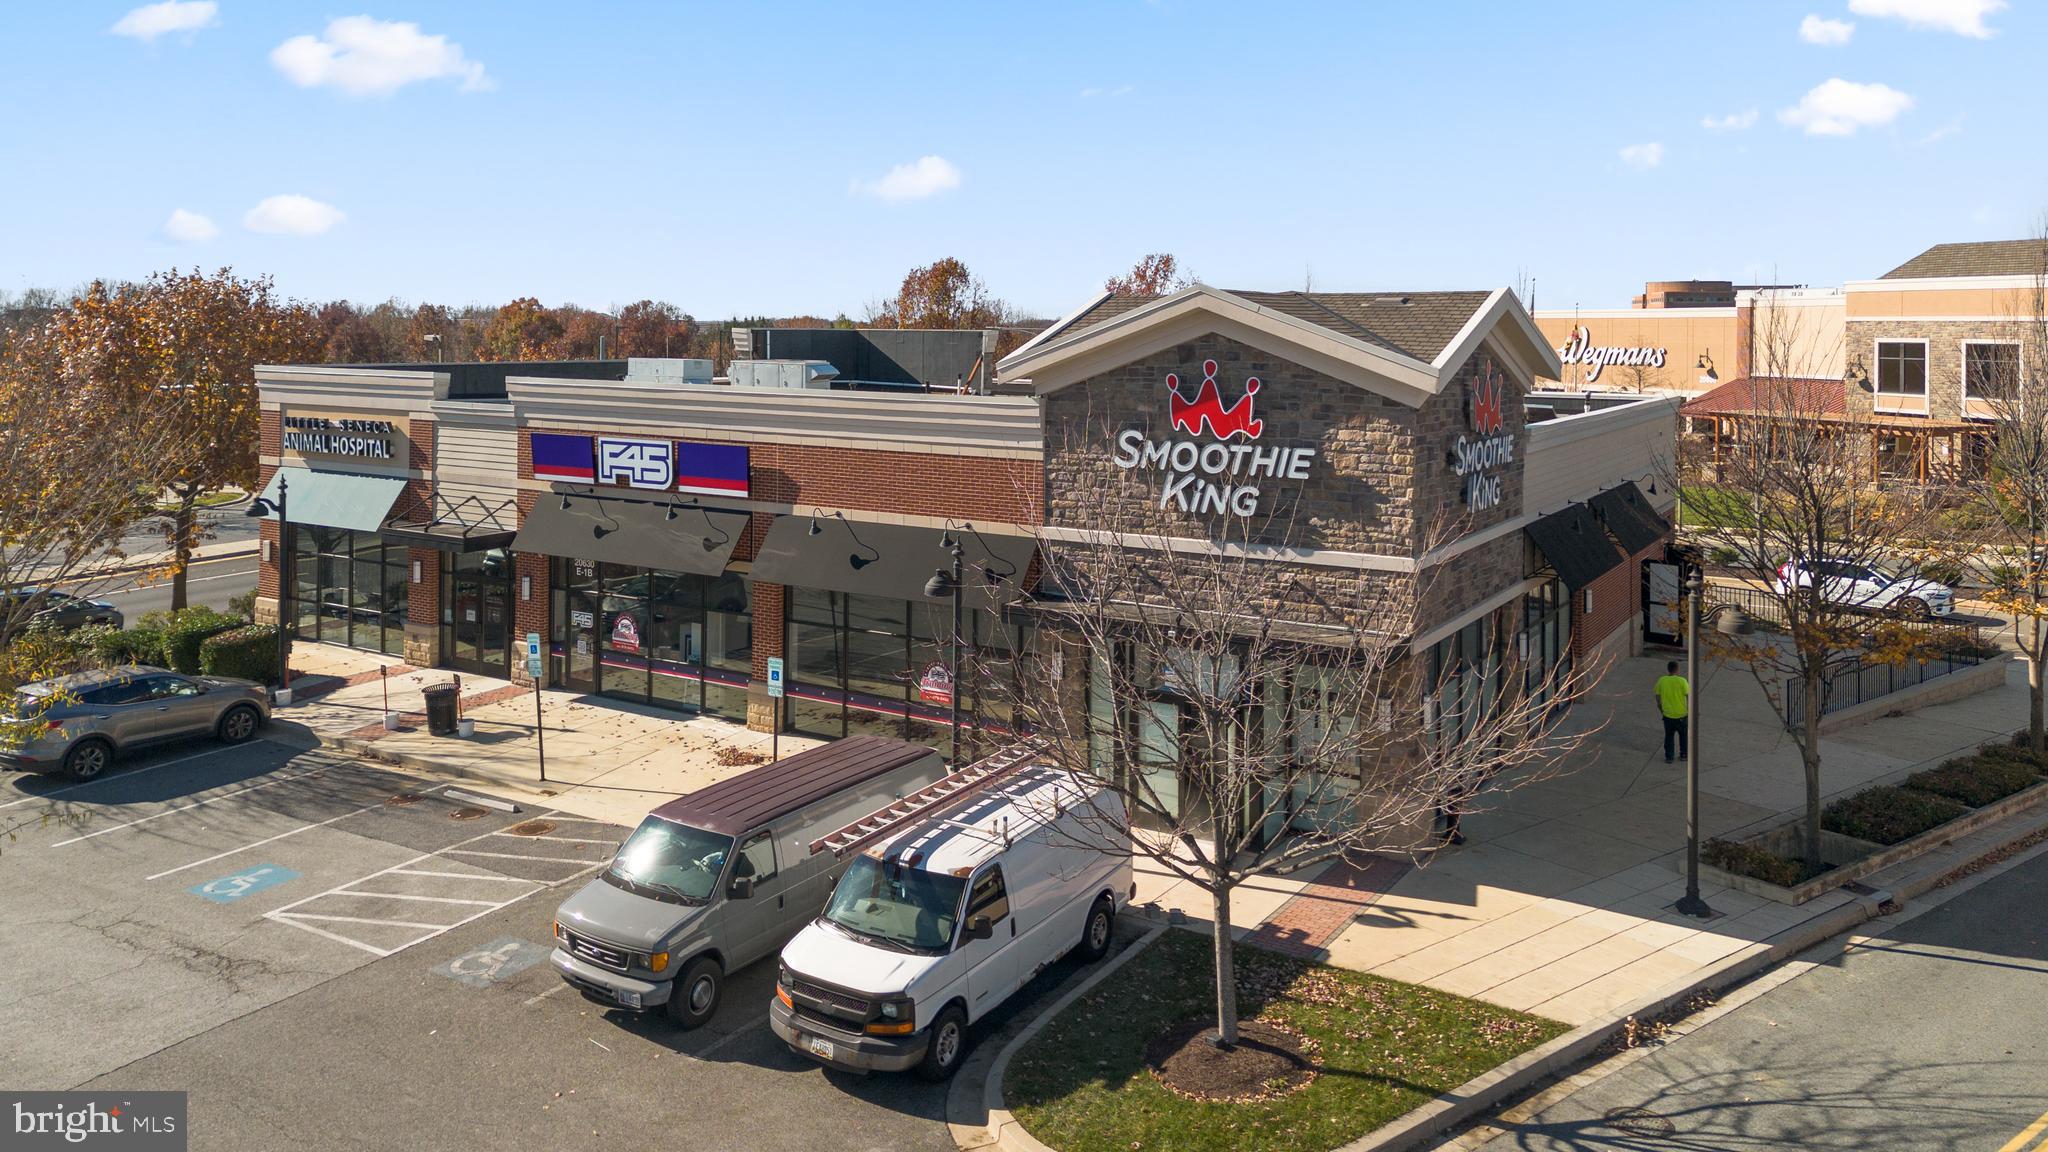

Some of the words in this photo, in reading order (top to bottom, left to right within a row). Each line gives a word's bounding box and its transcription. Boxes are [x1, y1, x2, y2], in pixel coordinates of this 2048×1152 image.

[1558, 326, 1668, 382] Wegmans
[340, 419, 391, 434] SENECA
[284, 433, 329, 453] ANIMAL
[331, 437, 390, 459] HOSPITAL
[1114, 430, 1316, 480] SMOOTHIE
[1455, 434, 1515, 476] SMOOTHIE
[599, 438, 672, 490] F45
[574, 558, 595, 568] 20630
[576, 568, 593, 577] E-1B
[571, 610, 593, 628] F45
